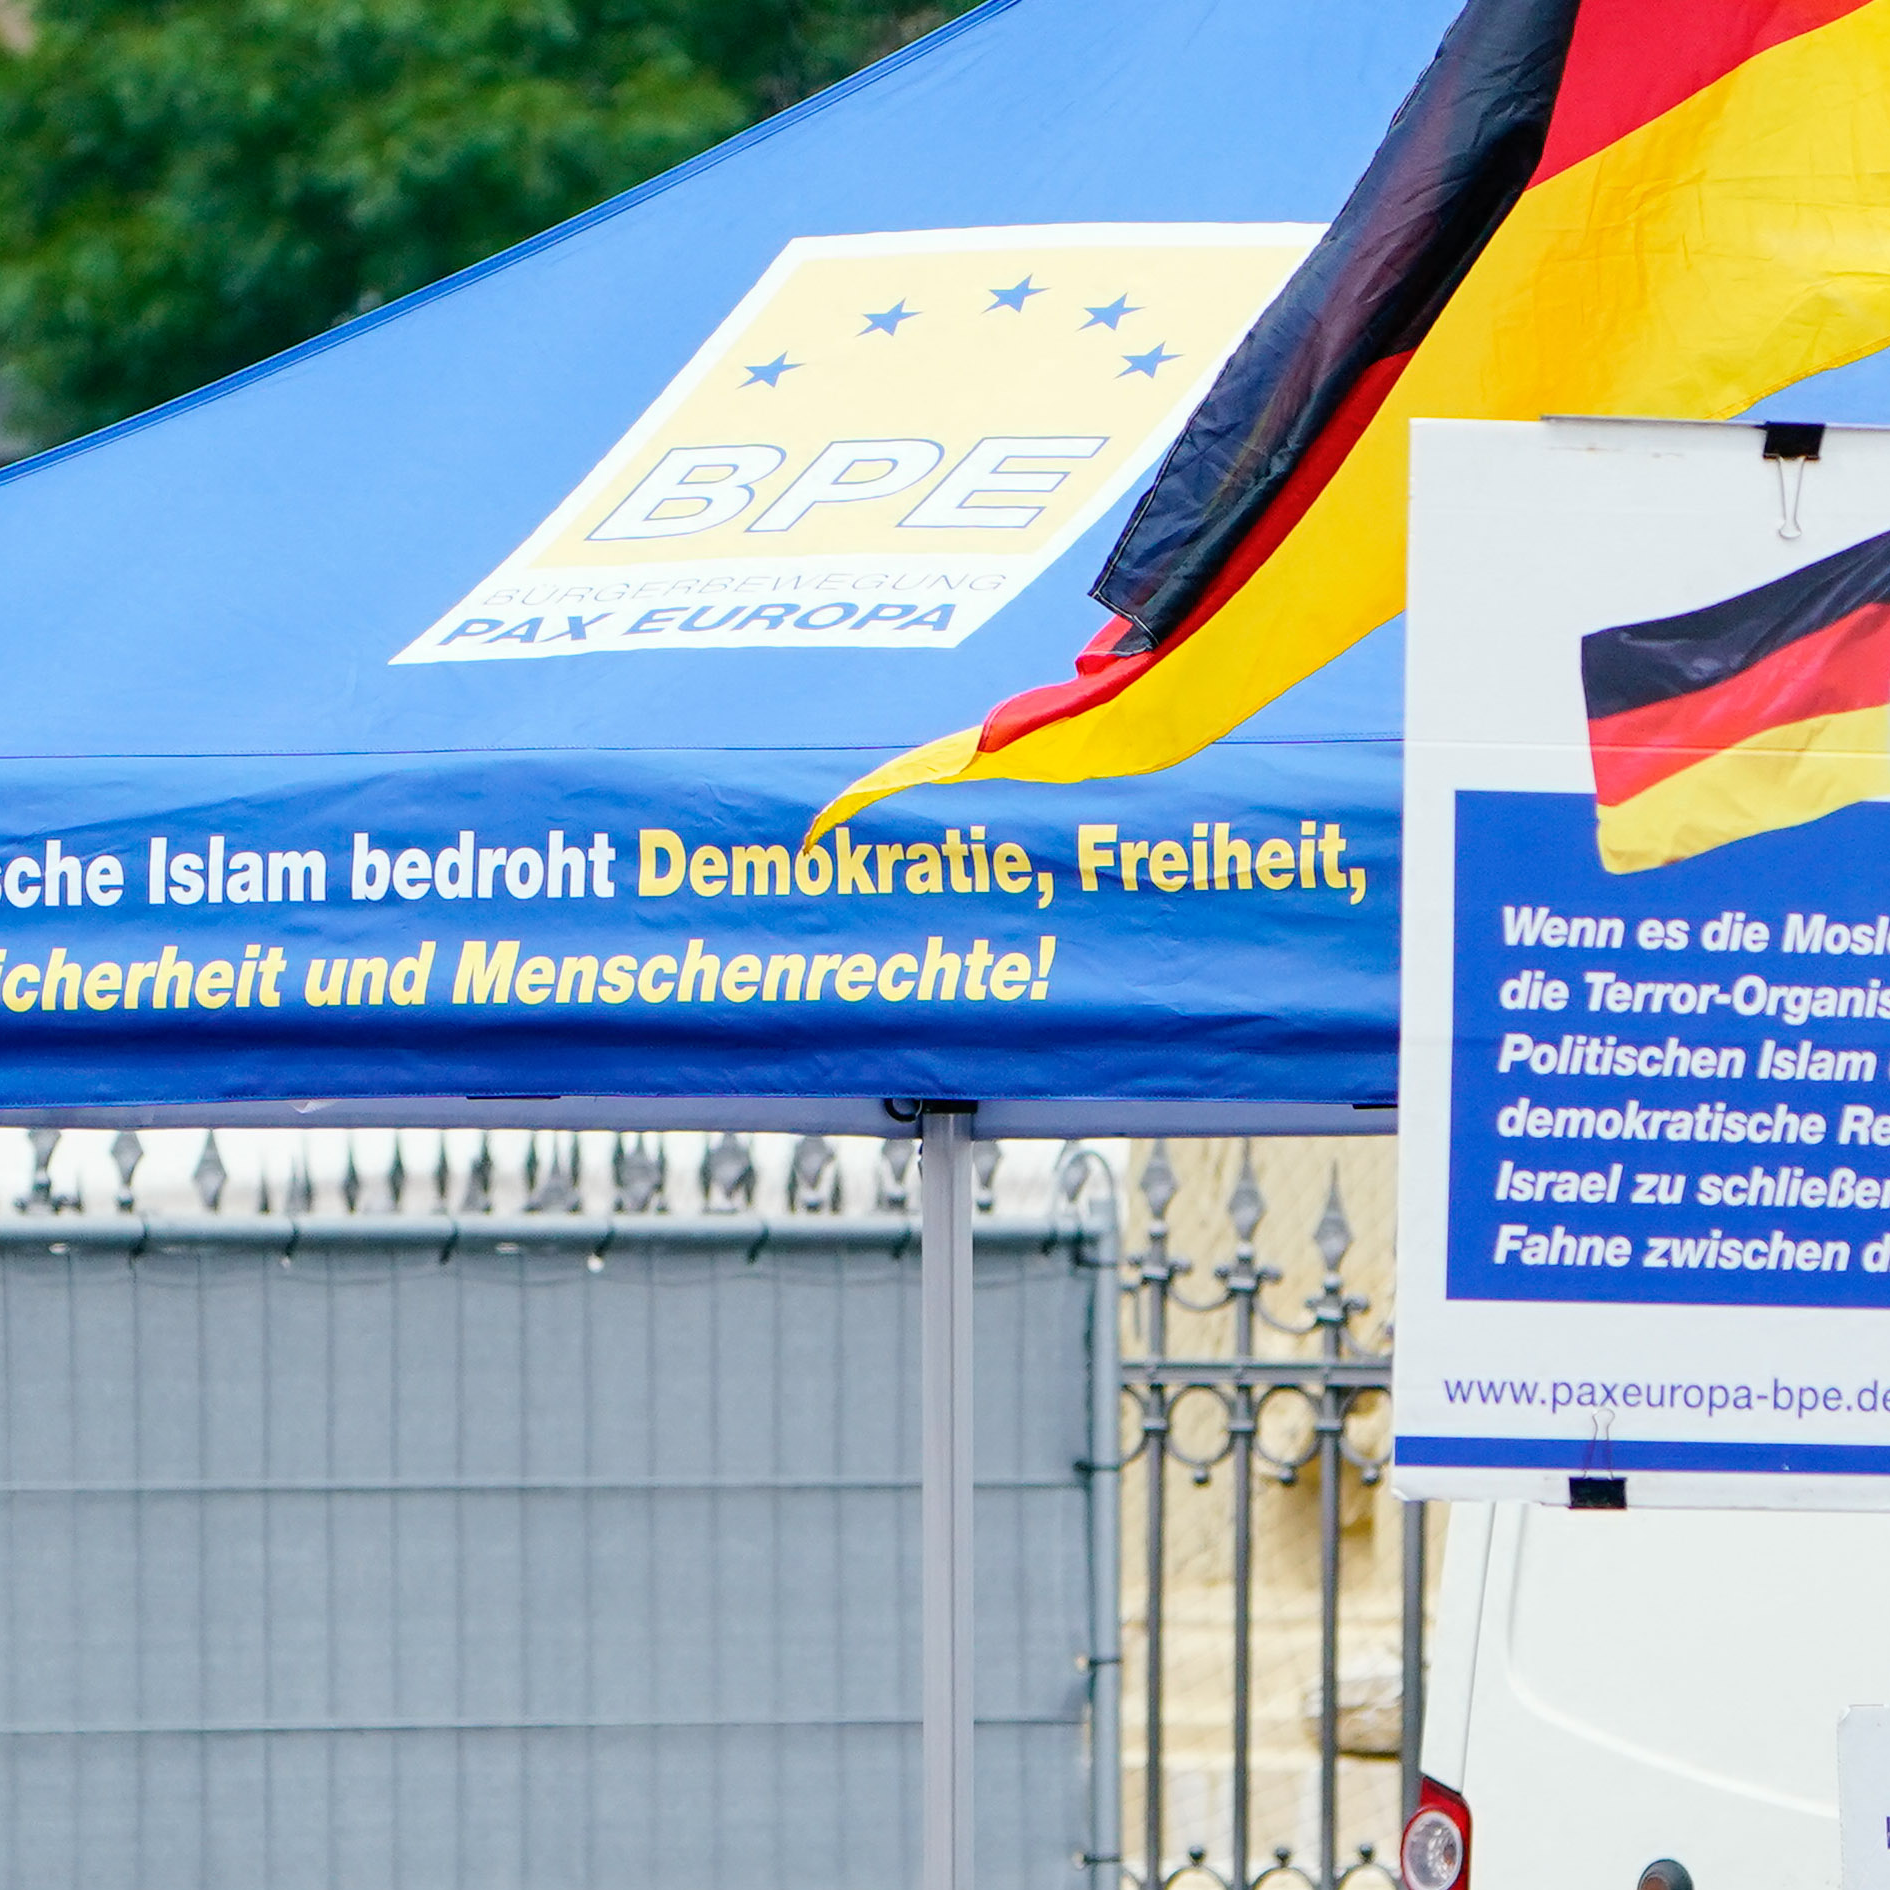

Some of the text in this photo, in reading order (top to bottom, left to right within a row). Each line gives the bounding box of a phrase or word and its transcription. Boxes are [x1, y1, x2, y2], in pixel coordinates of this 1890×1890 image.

[584, 436, 1111, 542] BPE
[484, 572, 1008, 607] BÜRGERBEWEGUNG
[435, 601, 959, 646] PAX EUROPA
[149, 834, 327, 906] Islam
[351, 829, 616, 901] bedroht
[638, 826, 1053, 910] Demokratie,
[1077, 820, 1368, 905] Freiheit,
[1501, 906, 1625, 949] Wenn
[1637, 917, 1689, 950] es
[1701, 912, 1770, 953] die
[308, 941, 437, 1009] und
[452, 935, 1058, 1006] Menschenrechte!
[1499, 970, 1569, 1011] die
[1497, 1033, 1746, 1078] Politischen
[1756, 1039, 1877, 1081] Islam
[1497, 1098, 1826, 1144] demokratische
[1496, 1161, 1623, 1203] Israel
[1630, 1172, 1686, 1205] zu
[1494, 1224, 1632, 1268] Fahne
[1643, 1229, 1851, 1273] zwischen
